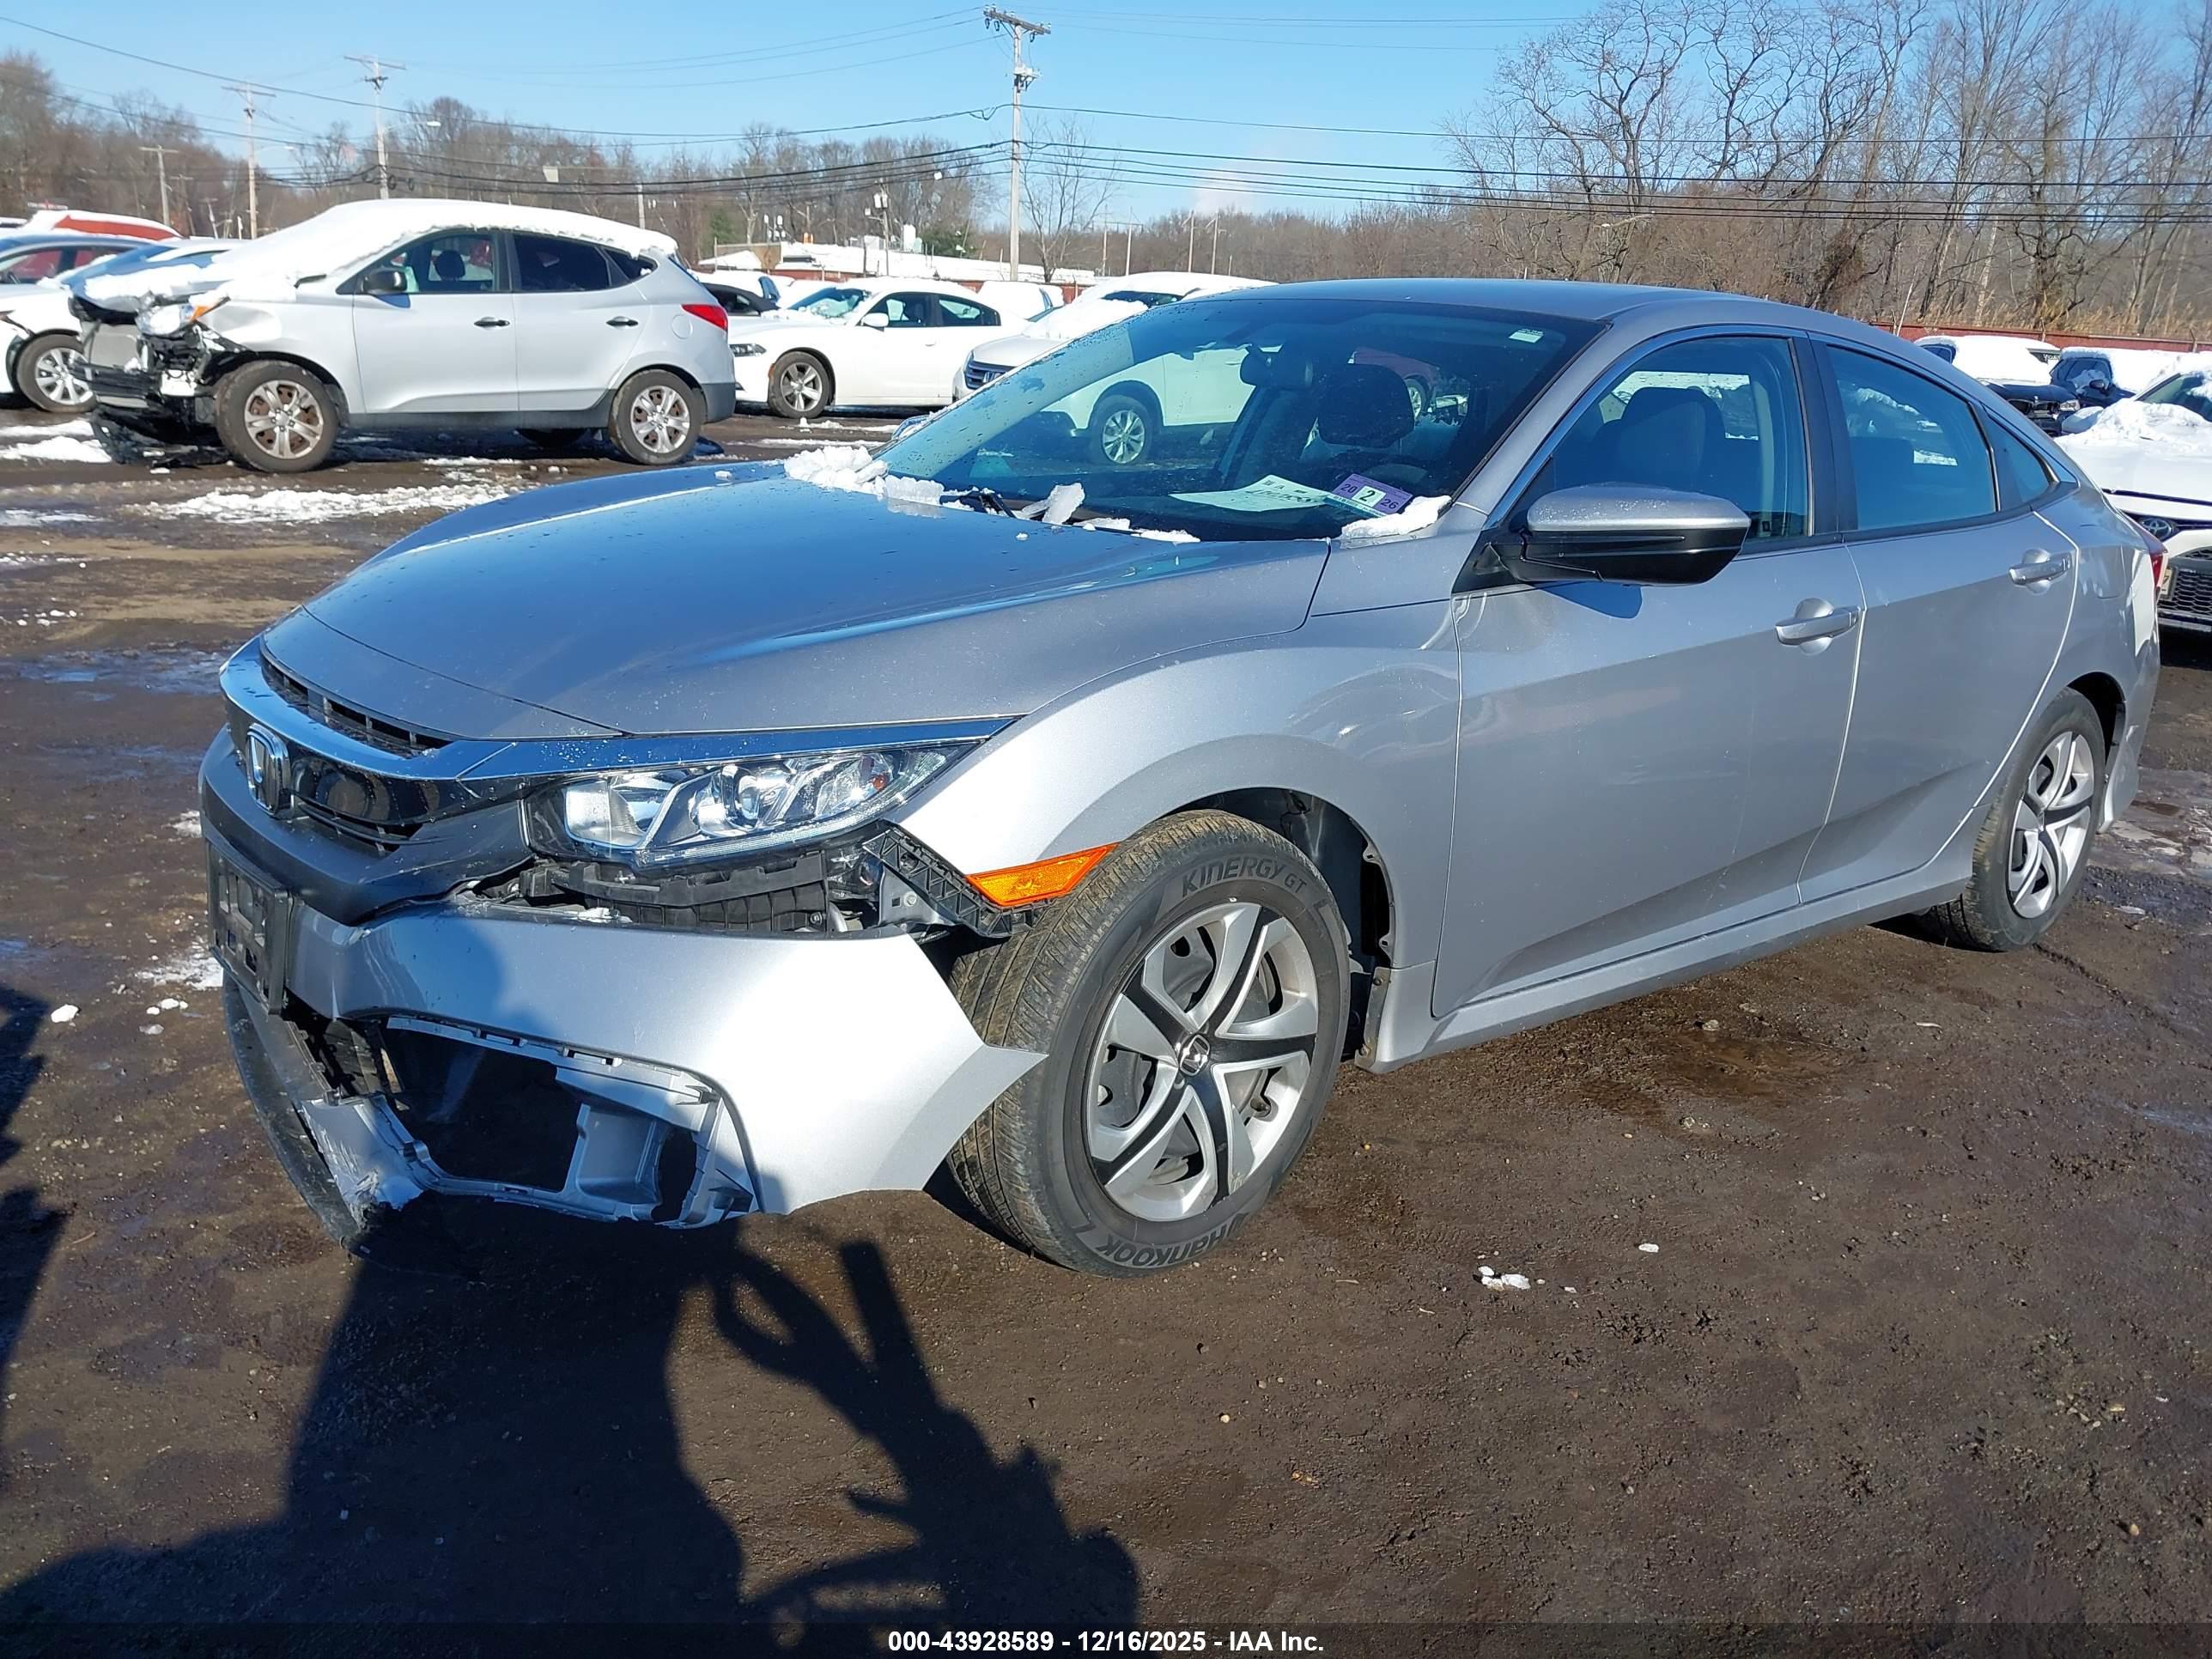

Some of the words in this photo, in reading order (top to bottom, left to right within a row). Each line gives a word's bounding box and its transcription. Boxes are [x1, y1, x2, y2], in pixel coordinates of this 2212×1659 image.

[1340, 483, 1358, 494] 20
[1359, 489, 1376, 502] 2
[1380, 498, 1399, 509] 26
[1284, 872, 1308, 894] GT
